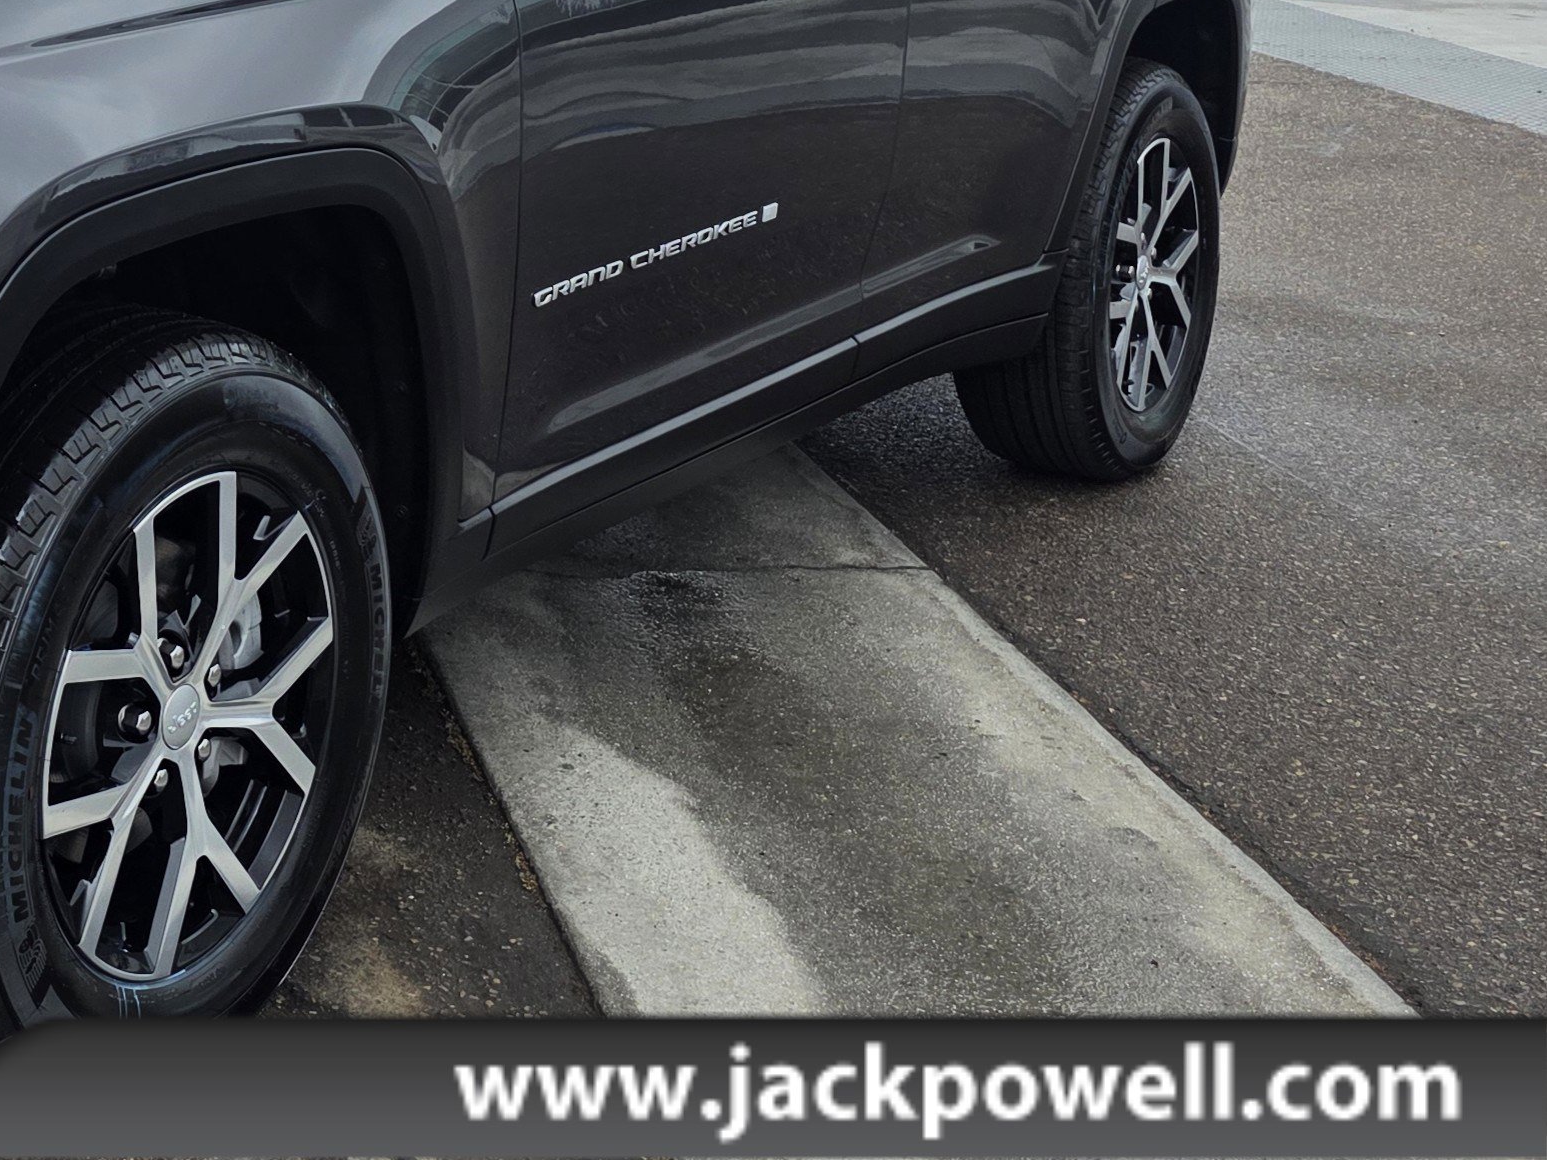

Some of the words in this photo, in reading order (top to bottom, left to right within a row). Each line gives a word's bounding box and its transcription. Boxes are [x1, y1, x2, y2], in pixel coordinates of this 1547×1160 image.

[534, 260, 624, 308] GRAND
[630, 210, 759, 270] CHEROKEE
[7, 716, 34, 924] MICHELIN
